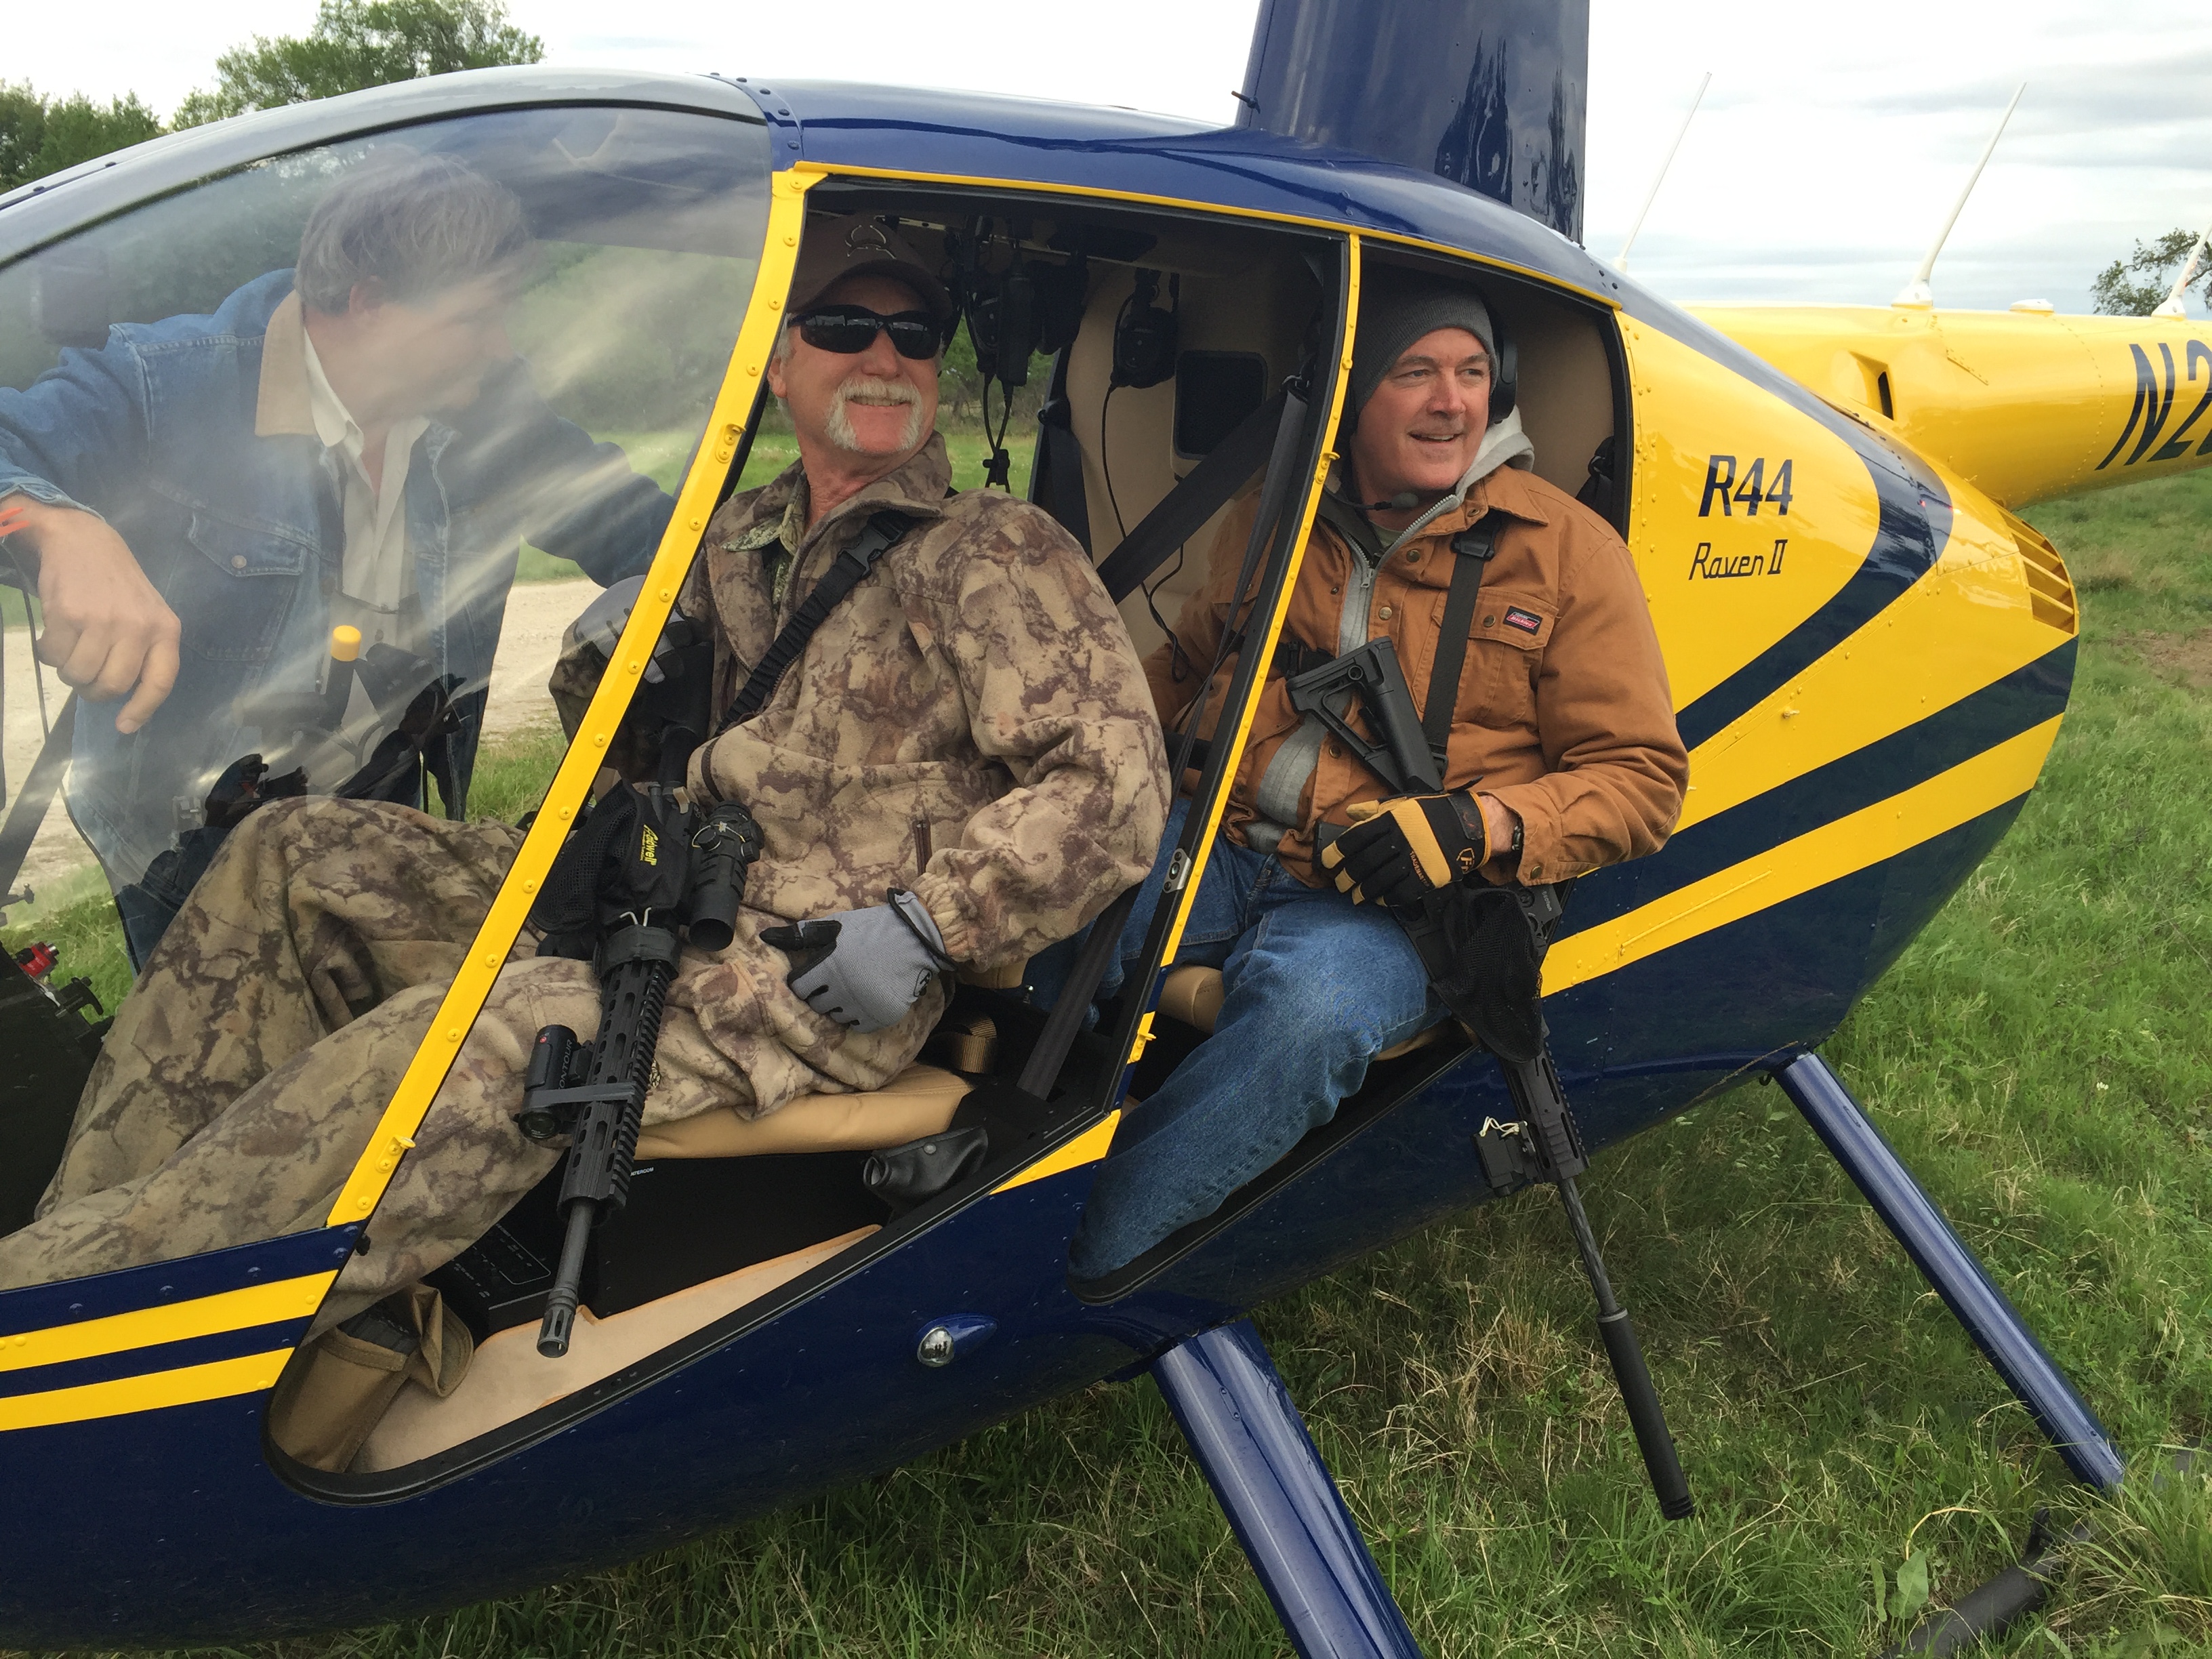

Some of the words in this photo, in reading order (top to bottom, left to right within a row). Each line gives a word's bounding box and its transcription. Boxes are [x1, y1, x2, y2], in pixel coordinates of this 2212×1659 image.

[2095, 340, 2212, 470] N2
[1698, 455, 1793, 517] R44
[1688, 542, 1764, 580] Raven
[1767, 539, 1788, 575] II
[558, 1038, 573, 1090] ONTOUR
